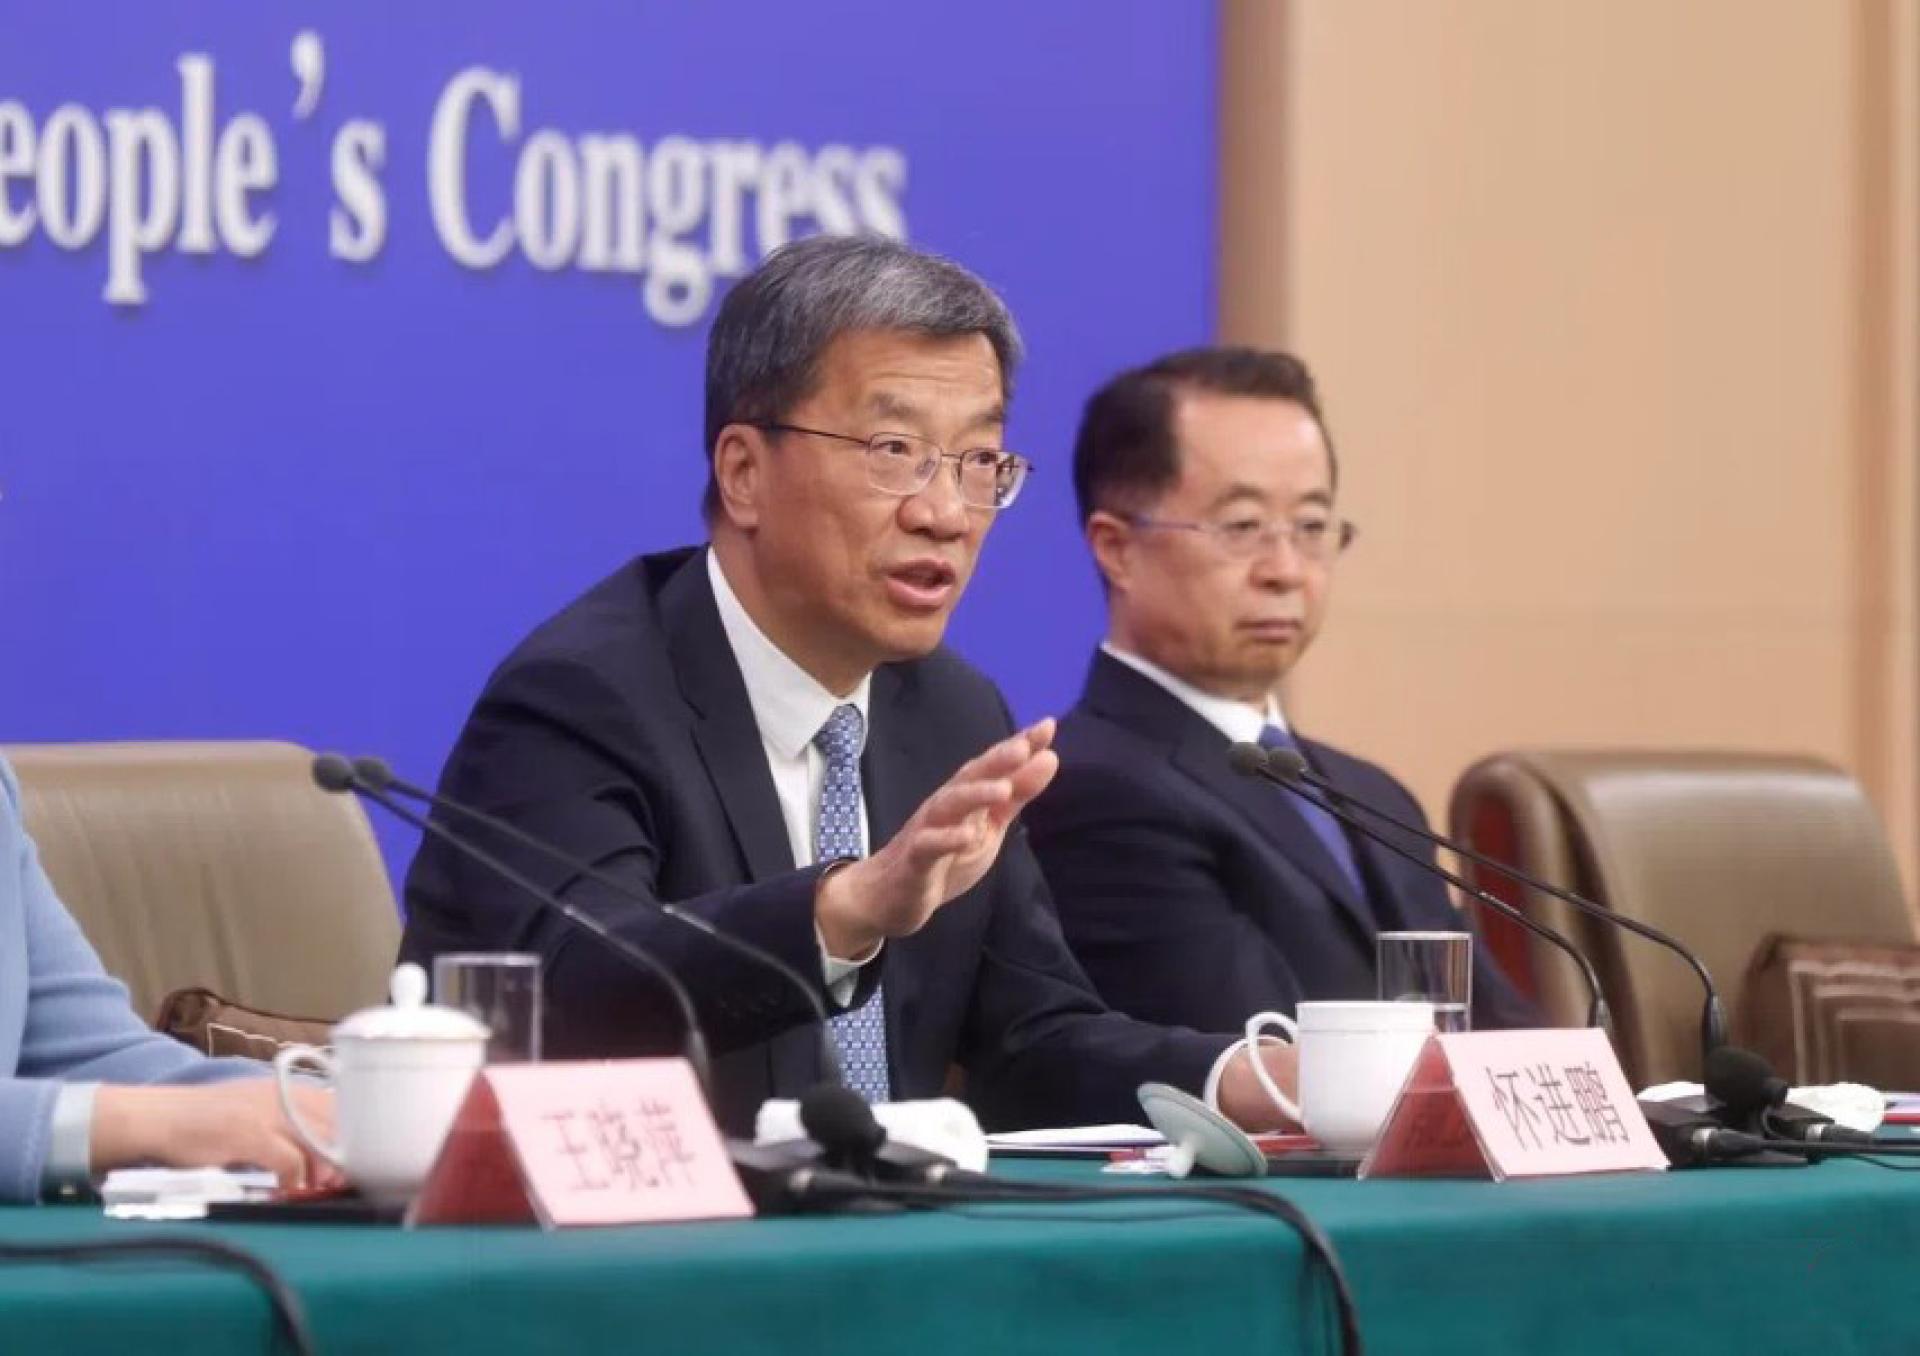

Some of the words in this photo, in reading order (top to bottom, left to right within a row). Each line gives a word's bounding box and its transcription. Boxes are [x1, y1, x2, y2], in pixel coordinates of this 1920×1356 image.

[428, 66, 908, 326] Congress
[1485, 1062, 1630, 1151] 怀进鹏
